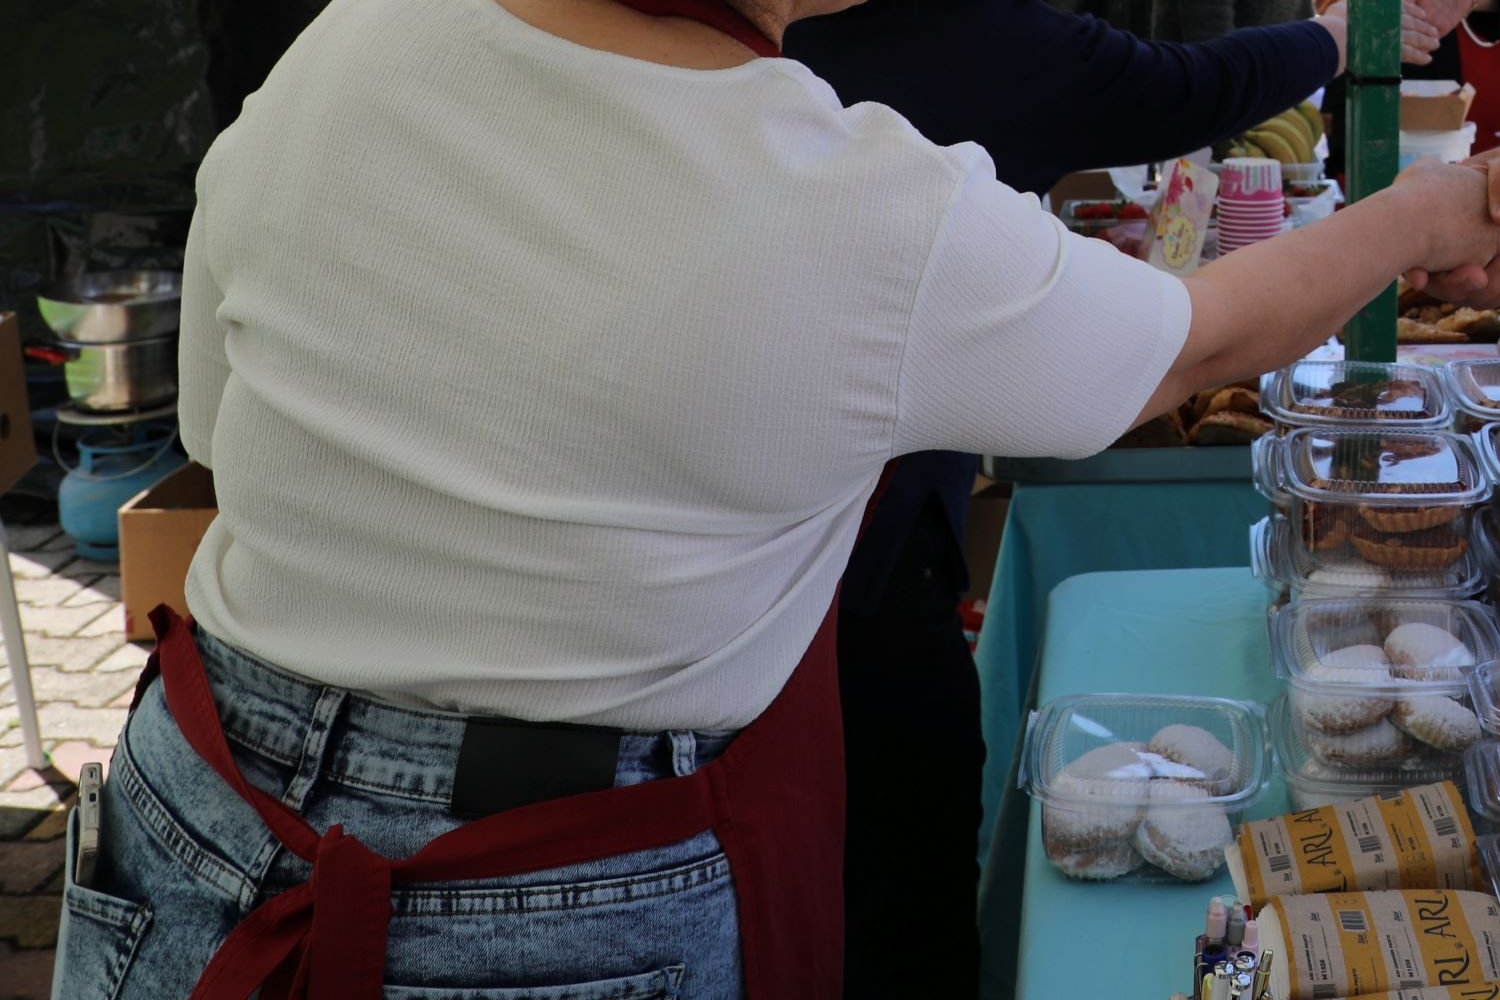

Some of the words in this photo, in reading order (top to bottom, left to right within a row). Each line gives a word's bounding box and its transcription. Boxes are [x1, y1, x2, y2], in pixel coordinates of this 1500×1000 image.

[1300, 827, 1336, 866] ARI
[1414, 894, 1456, 938] ARI
[1434, 949, 1470, 985] RI
